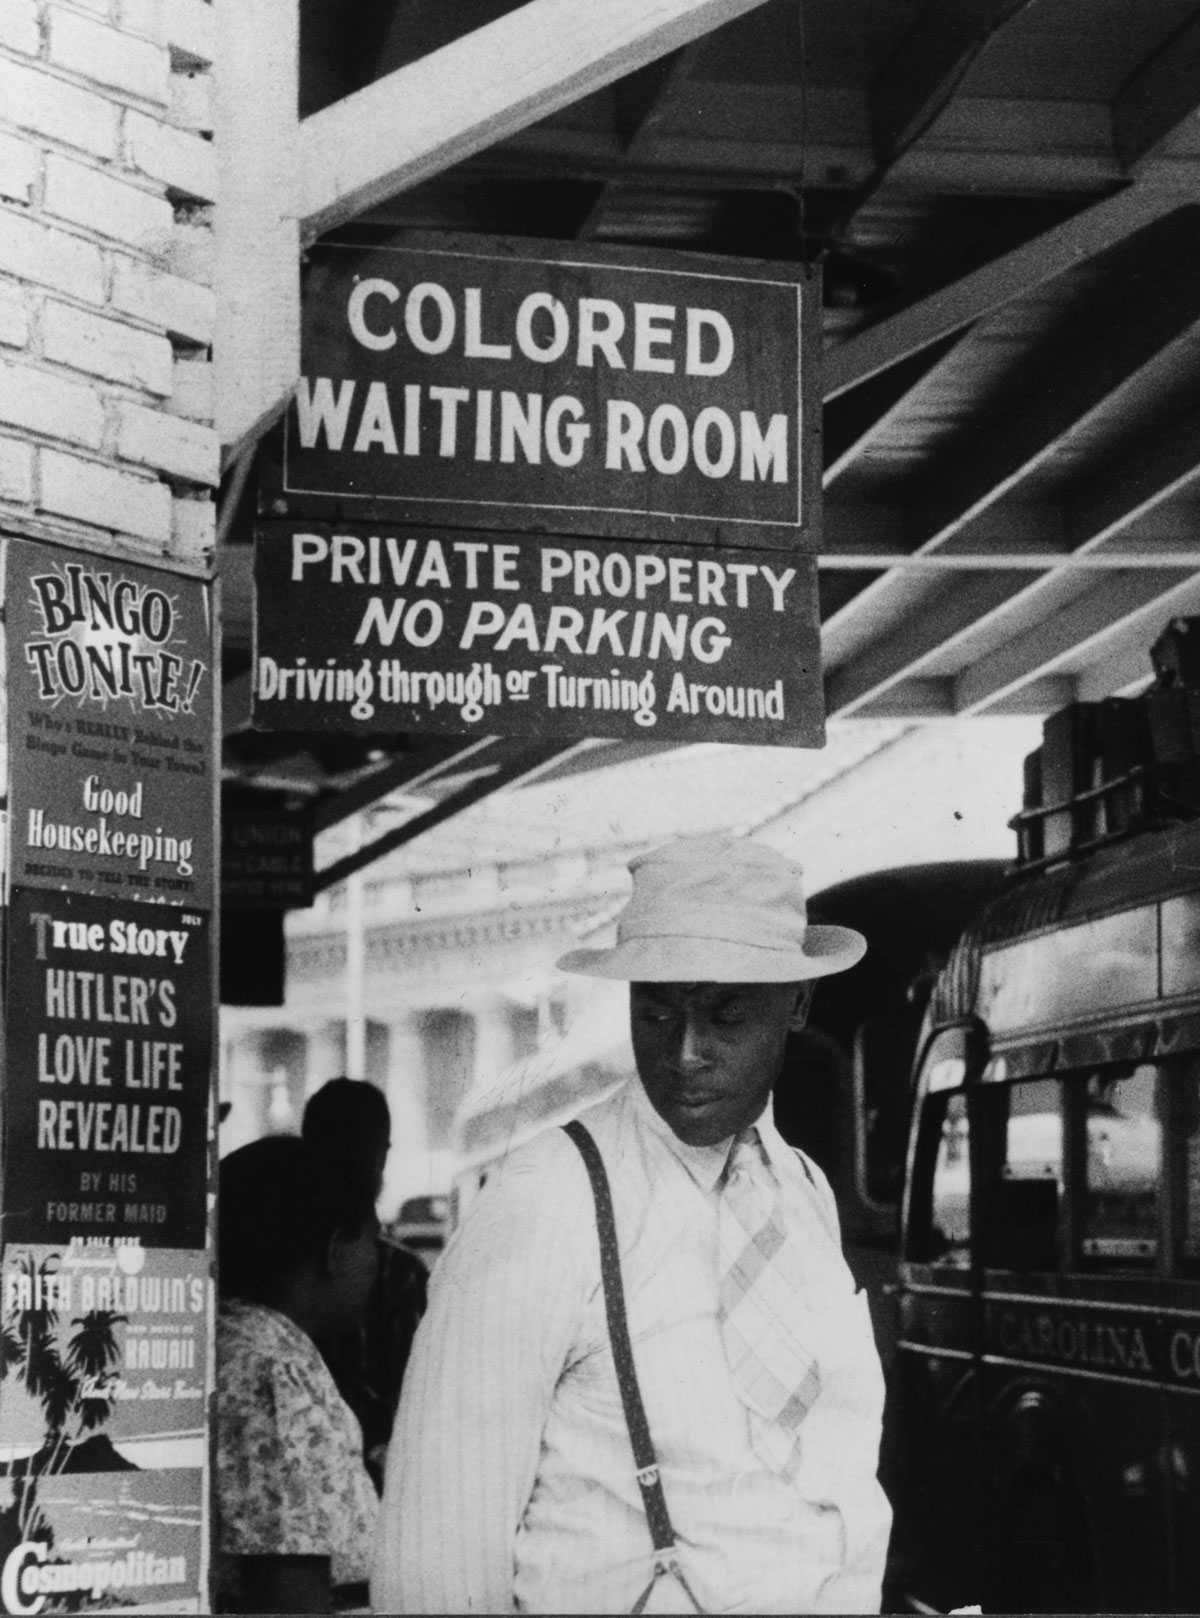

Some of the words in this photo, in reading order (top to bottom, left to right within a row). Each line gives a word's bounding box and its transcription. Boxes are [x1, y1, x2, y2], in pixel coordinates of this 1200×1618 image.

[347, 278, 735, 377] COLORED
[299, 375, 591, 467] WAITING
[604, 399, 789, 483] ROOM
[32, 564, 173, 644] BINGO
[291, 533, 521, 590] PRIVATE
[540, 547, 797, 611] PROPERTY
[354, 597, 443, 648] NO
[459, 601, 732, 663] PARKING
[26, 639, 205, 712] TONITE!
[259, 657, 374, 720] Driving
[377, 659, 502, 722] through
[506, 670, 538, 700] or
[541, 664, 657, 726] Turning
[667, 673, 784, 721] Around
[83, 775, 142, 818] Good
[27, 808, 193, 876] Housekeeping
[30, 912, 105, 960] True
[109, 919, 189, 964] Story
[46, 968, 177, 1027] HITLER'S
[38, 1033, 111, 1086] LOVE
[126, 1039, 183, 1090] LIFE
[37, 1099, 182, 1154] REVEALED
[47, 1202, 116, 1223] FORMER
[124, 1202, 167, 1224] MAID
[80, 1171, 101, 1192] BY
[109, 1173, 137, 1193] HIS
[1001, 1313, 1154, 1370] CAROLINA
[2, 1542, 186, 1615] Cosmopolitan
